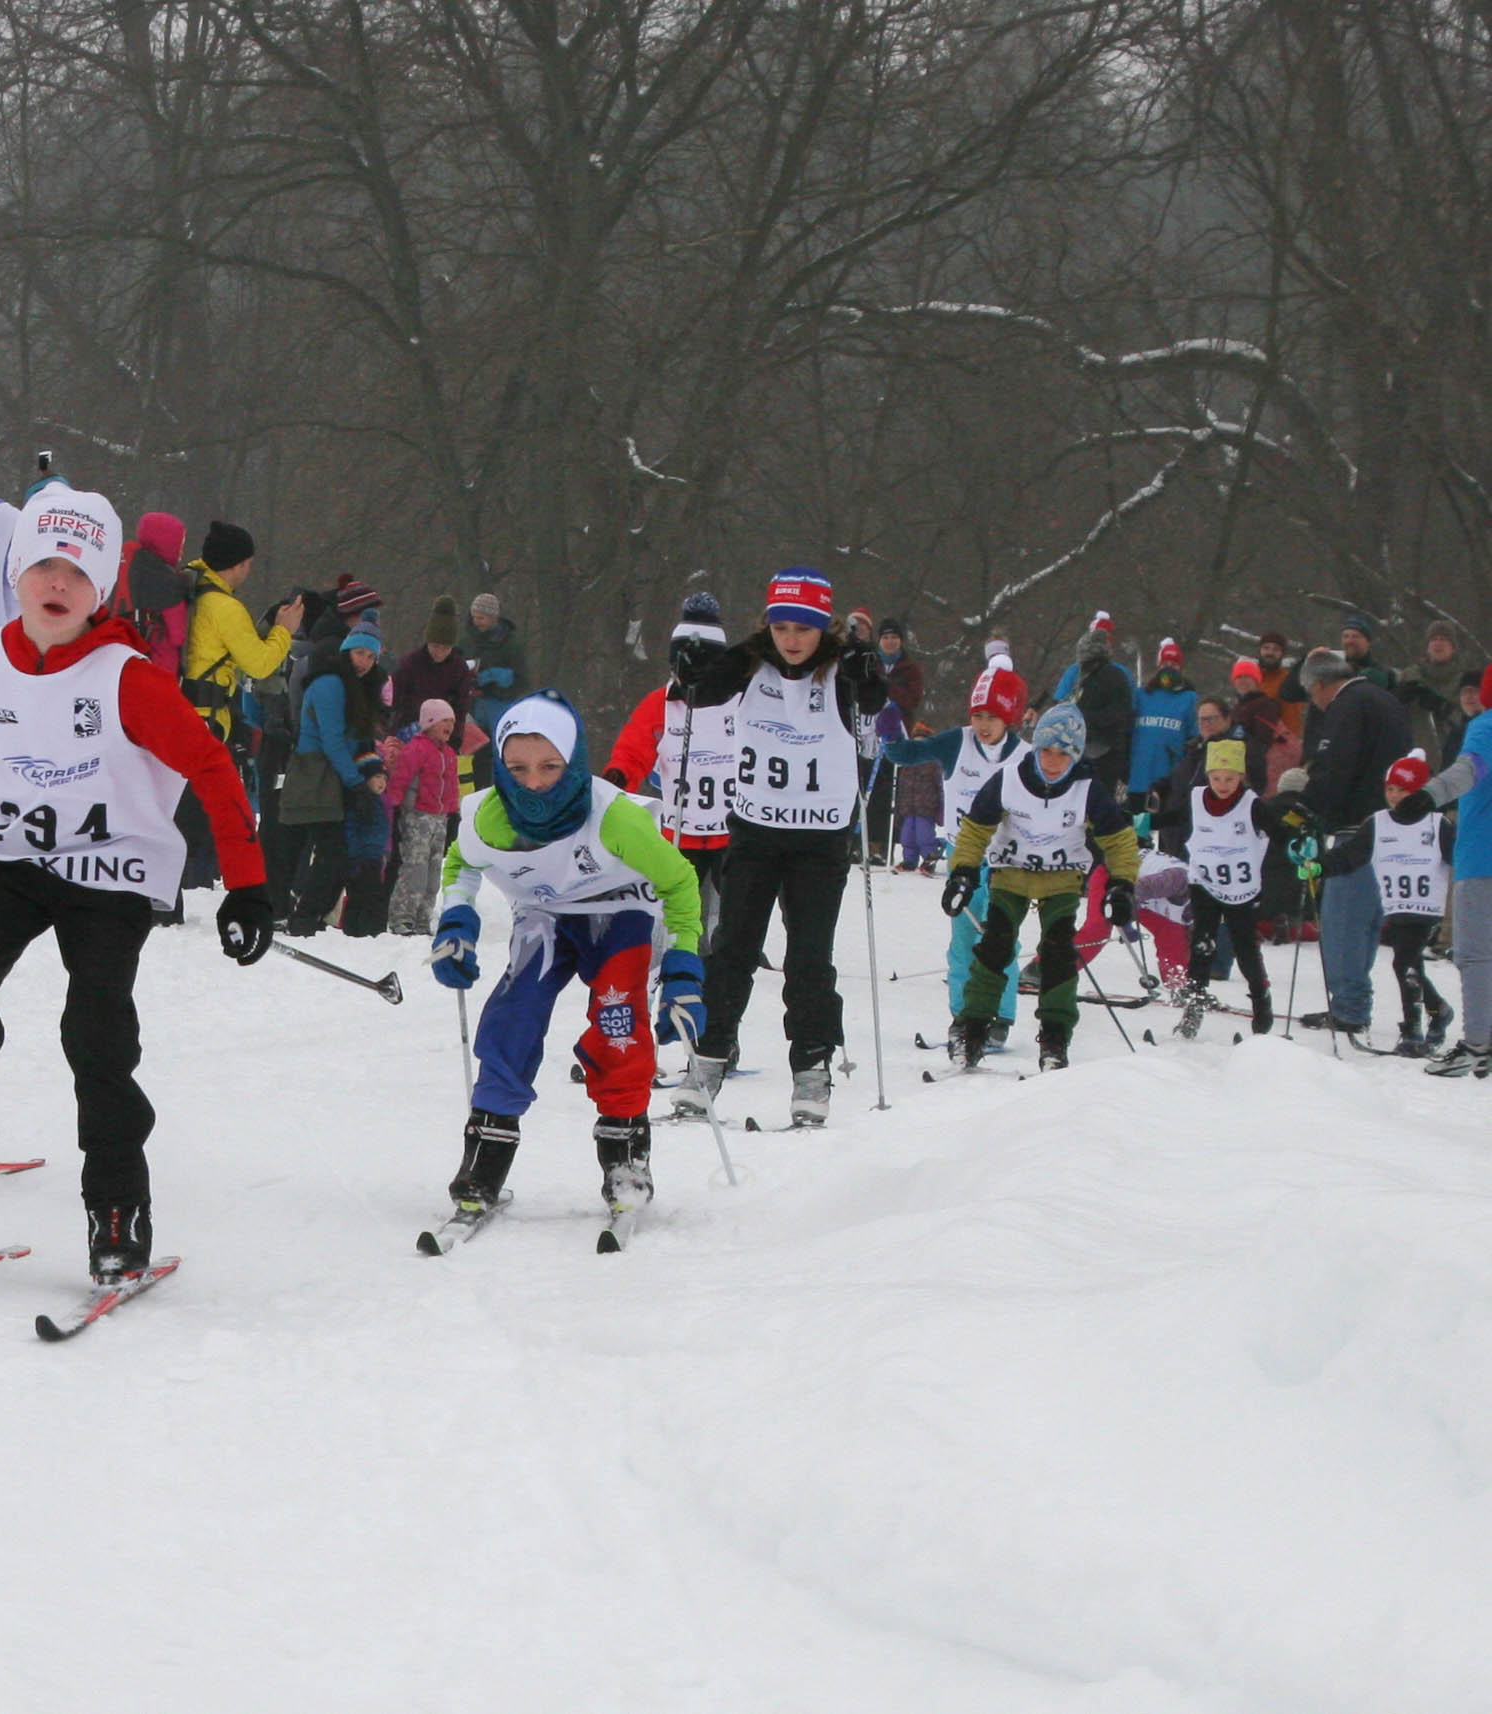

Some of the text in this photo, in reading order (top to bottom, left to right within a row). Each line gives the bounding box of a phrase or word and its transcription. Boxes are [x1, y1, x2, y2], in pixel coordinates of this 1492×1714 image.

[38, 514, 107, 545] BIRKIE
[747, 720, 774, 734] LAKE
[738, 745, 820, 792] 291
[760, 806, 840, 825] SKIING
[20, 856, 146, 883] KIING
